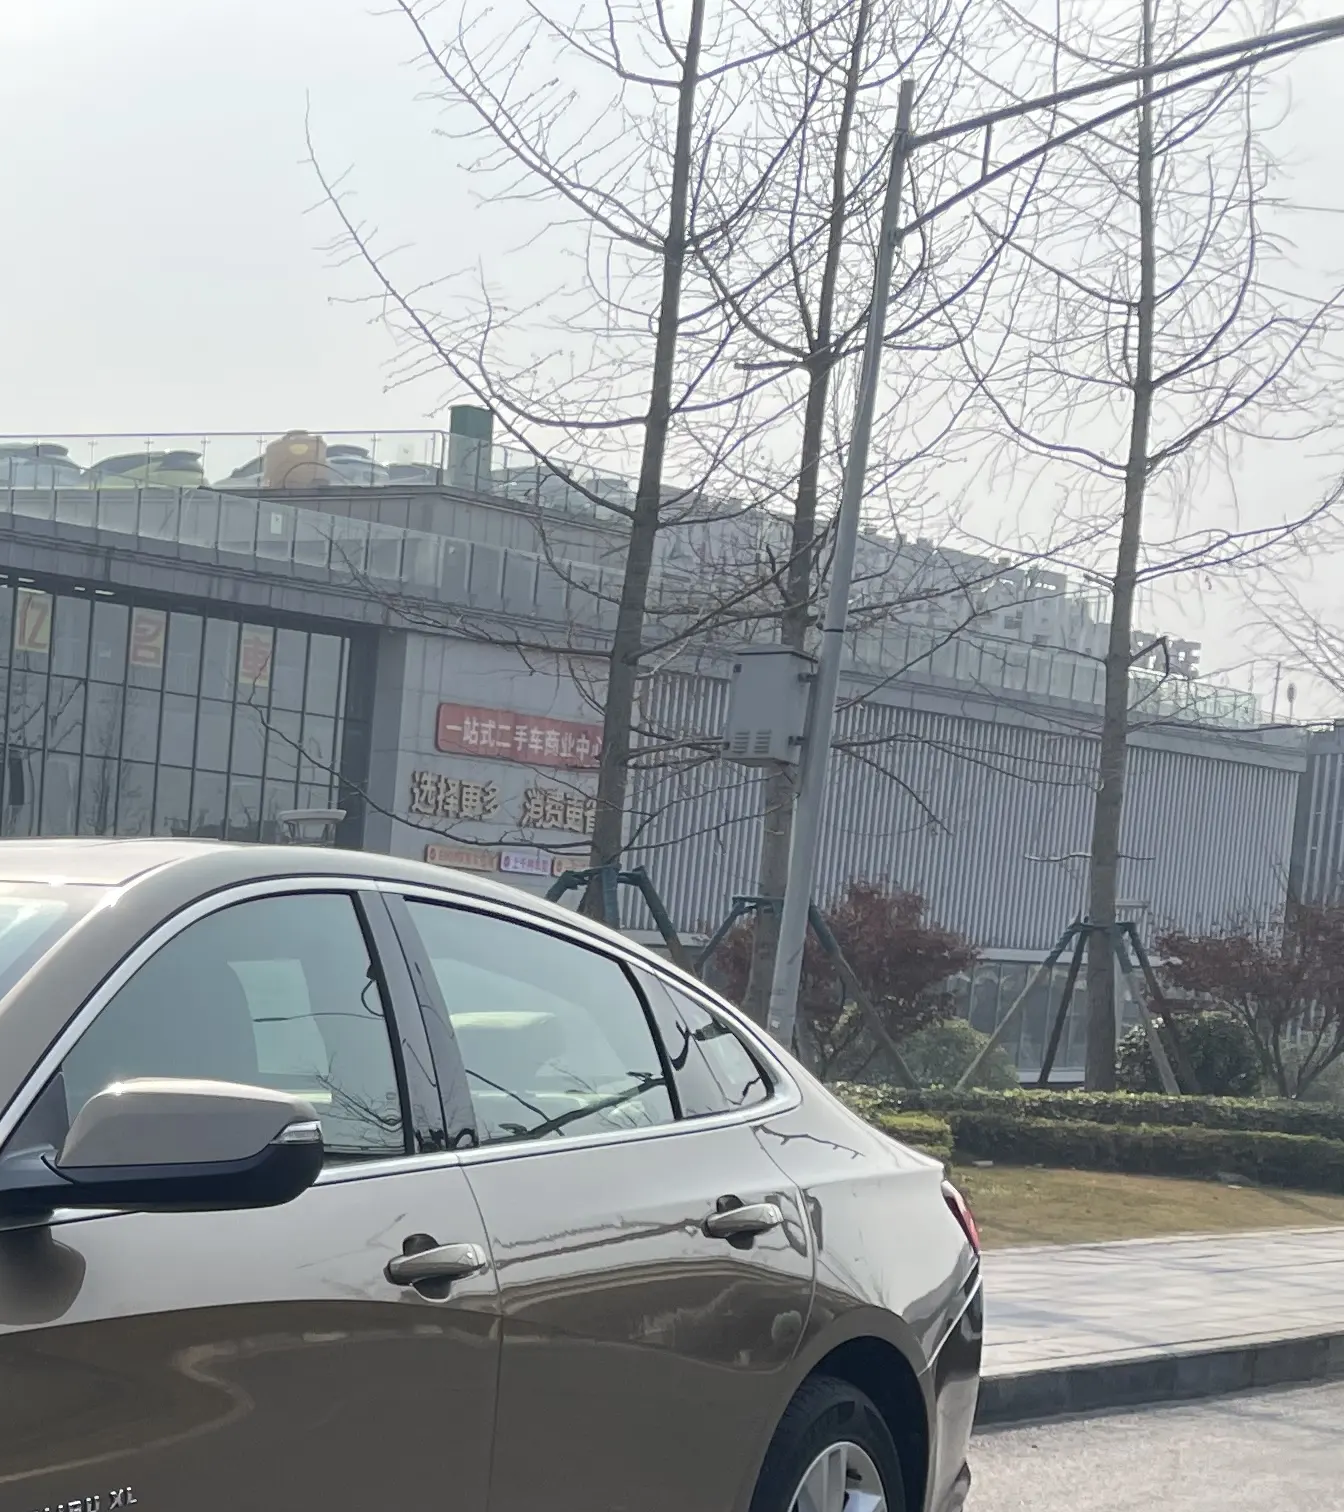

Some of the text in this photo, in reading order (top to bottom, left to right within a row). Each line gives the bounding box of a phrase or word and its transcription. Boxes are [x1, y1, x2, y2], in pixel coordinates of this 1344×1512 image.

[410, 771, 500, 820] 选择更多
[109, 1486, 138, 1511] XL
